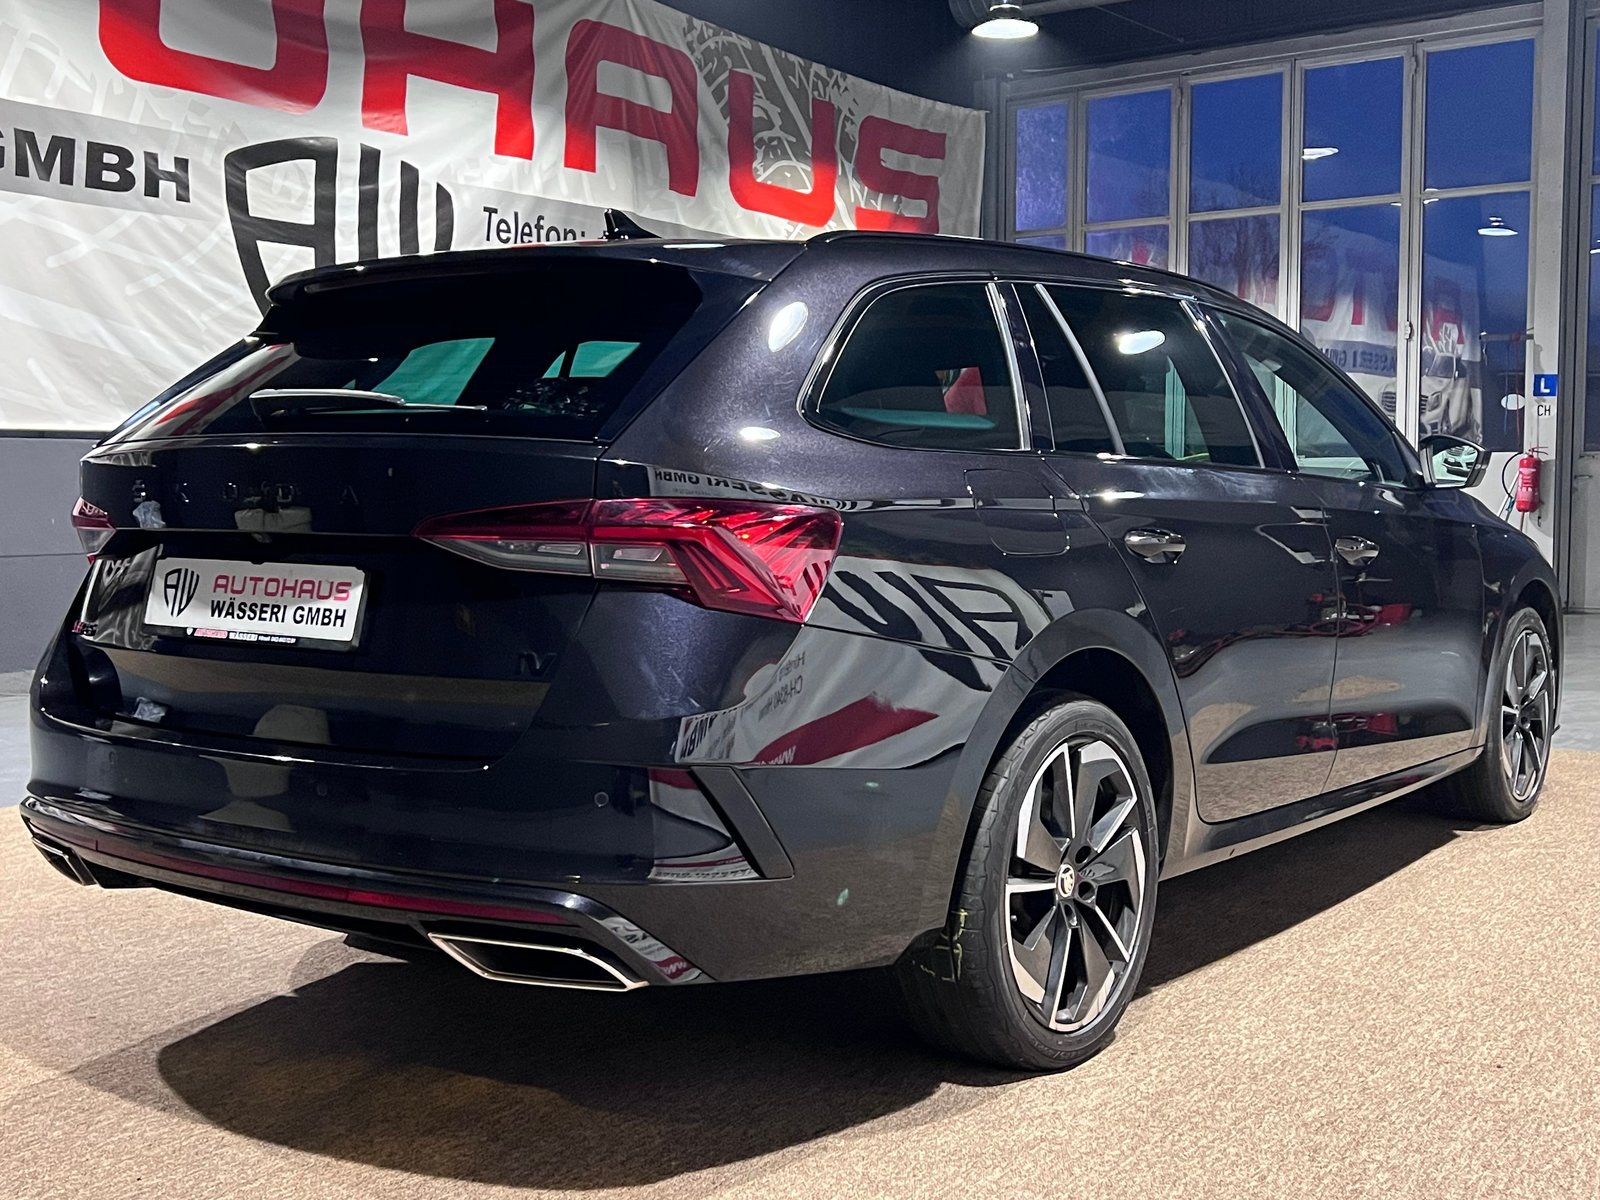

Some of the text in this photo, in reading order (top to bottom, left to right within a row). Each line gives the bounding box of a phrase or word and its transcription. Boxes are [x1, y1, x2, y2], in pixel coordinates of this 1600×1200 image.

[0, 127, 191, 203] MBH
[1537, 404, 1551, 417] CH
[212, 574, 352, 602] AUTOHAUS
[209, 597, 347, 628] WÄSSERI GMBH
